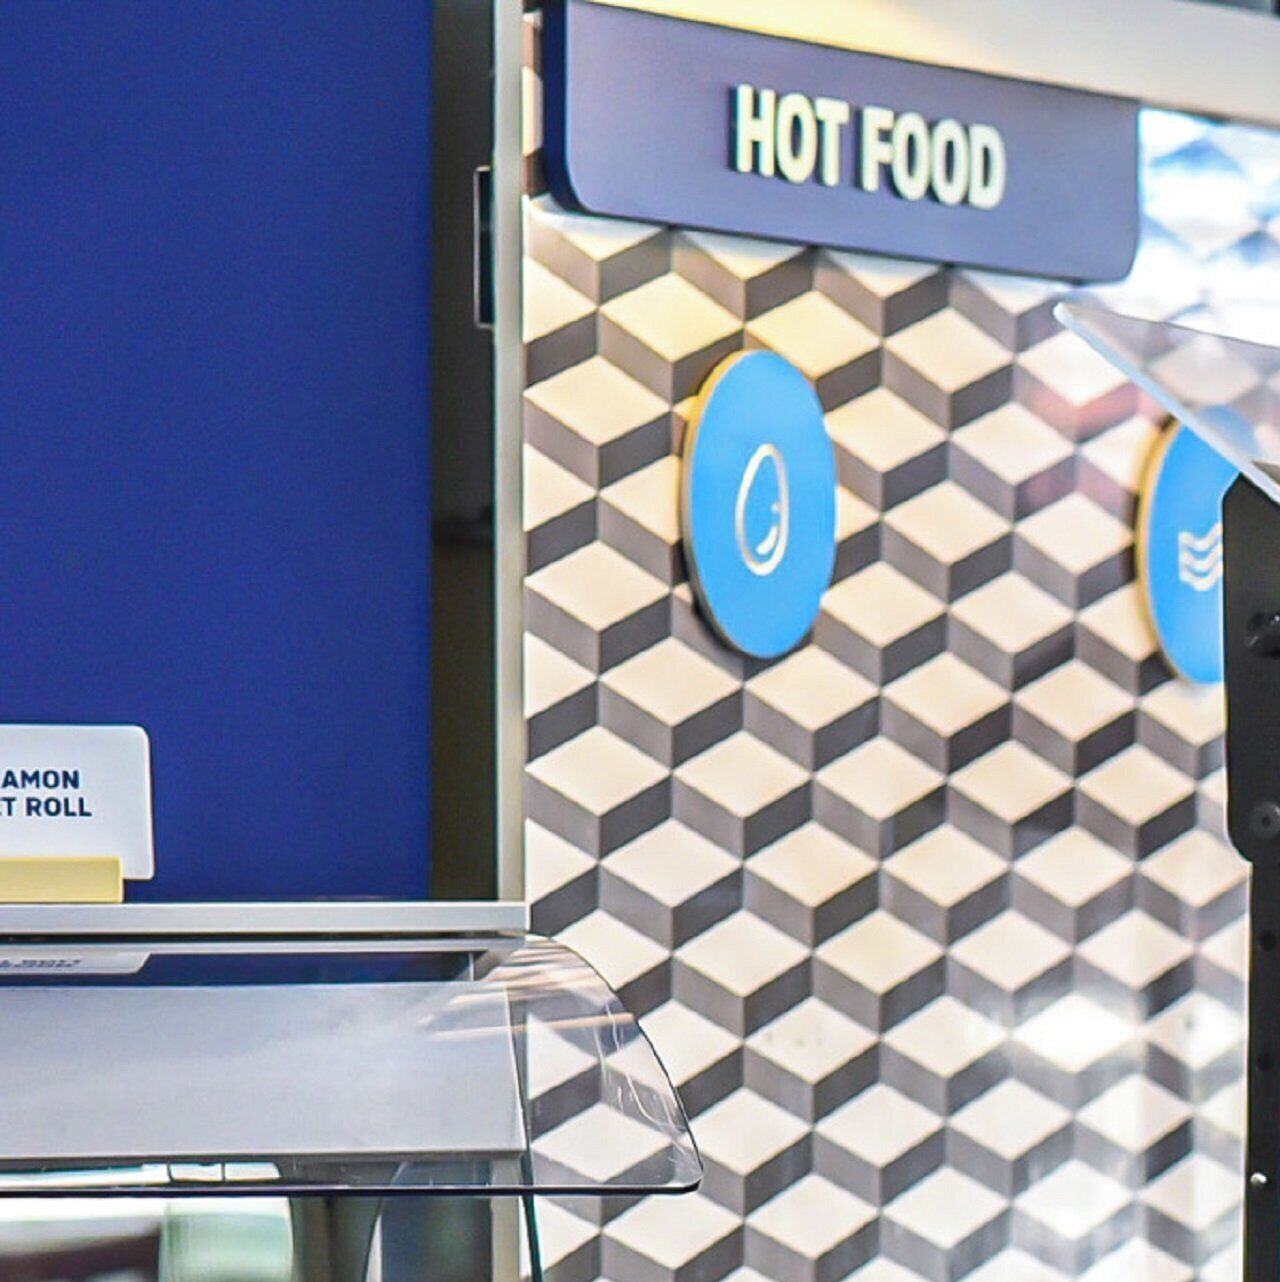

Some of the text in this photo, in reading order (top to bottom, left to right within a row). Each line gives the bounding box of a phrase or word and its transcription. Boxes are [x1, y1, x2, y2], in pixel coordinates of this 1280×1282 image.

[733, 84, 1007, 211] HOT FOOD
[1, 769, 80, 789] AMON
[0, 796, 92, 817] T ROLL
